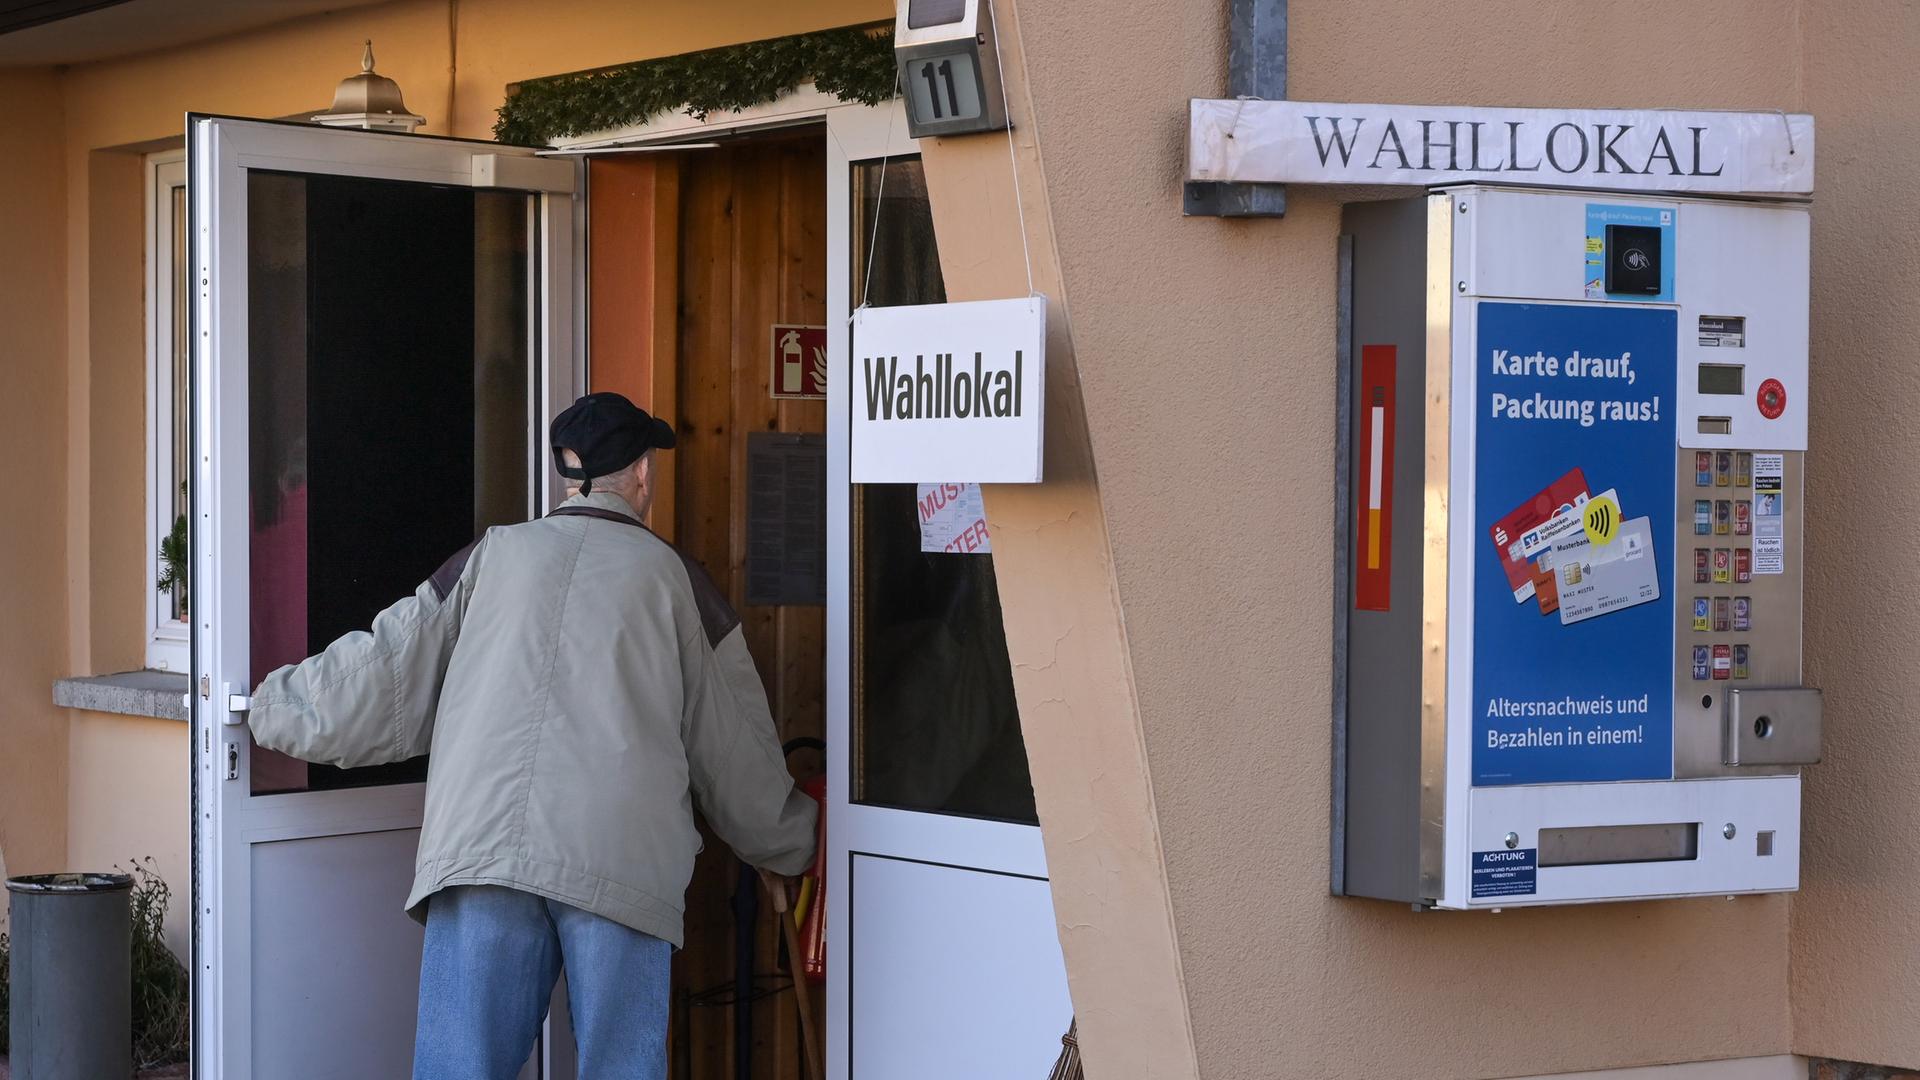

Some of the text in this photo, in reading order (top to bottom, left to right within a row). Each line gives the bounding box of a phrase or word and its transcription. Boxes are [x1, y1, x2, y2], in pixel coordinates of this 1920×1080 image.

[922, 59, 960, 119] 11
[1304, 116, 1725, 178] WAHLLOKAL
[1492, 349, 1636, 385] Karte drauf,
[863, 350, 1023, 421] Wahllokal
[1491, 392, 1660, 427] Packung raus!
[918, 483, 965, 523] MUS
[1539, 516, 1569, 535] Volksbanken
[1541, 518, 1581, 541] Raiffeisenbanken
[1556, 537, 1591, 552] Musterbank
[1487, 694, 1648, 718] Altersnachweis und
[1487, 724, 1643, 749] Bezahlen in einem!
[1482, 852, 1525, 862] ACHTUNG
